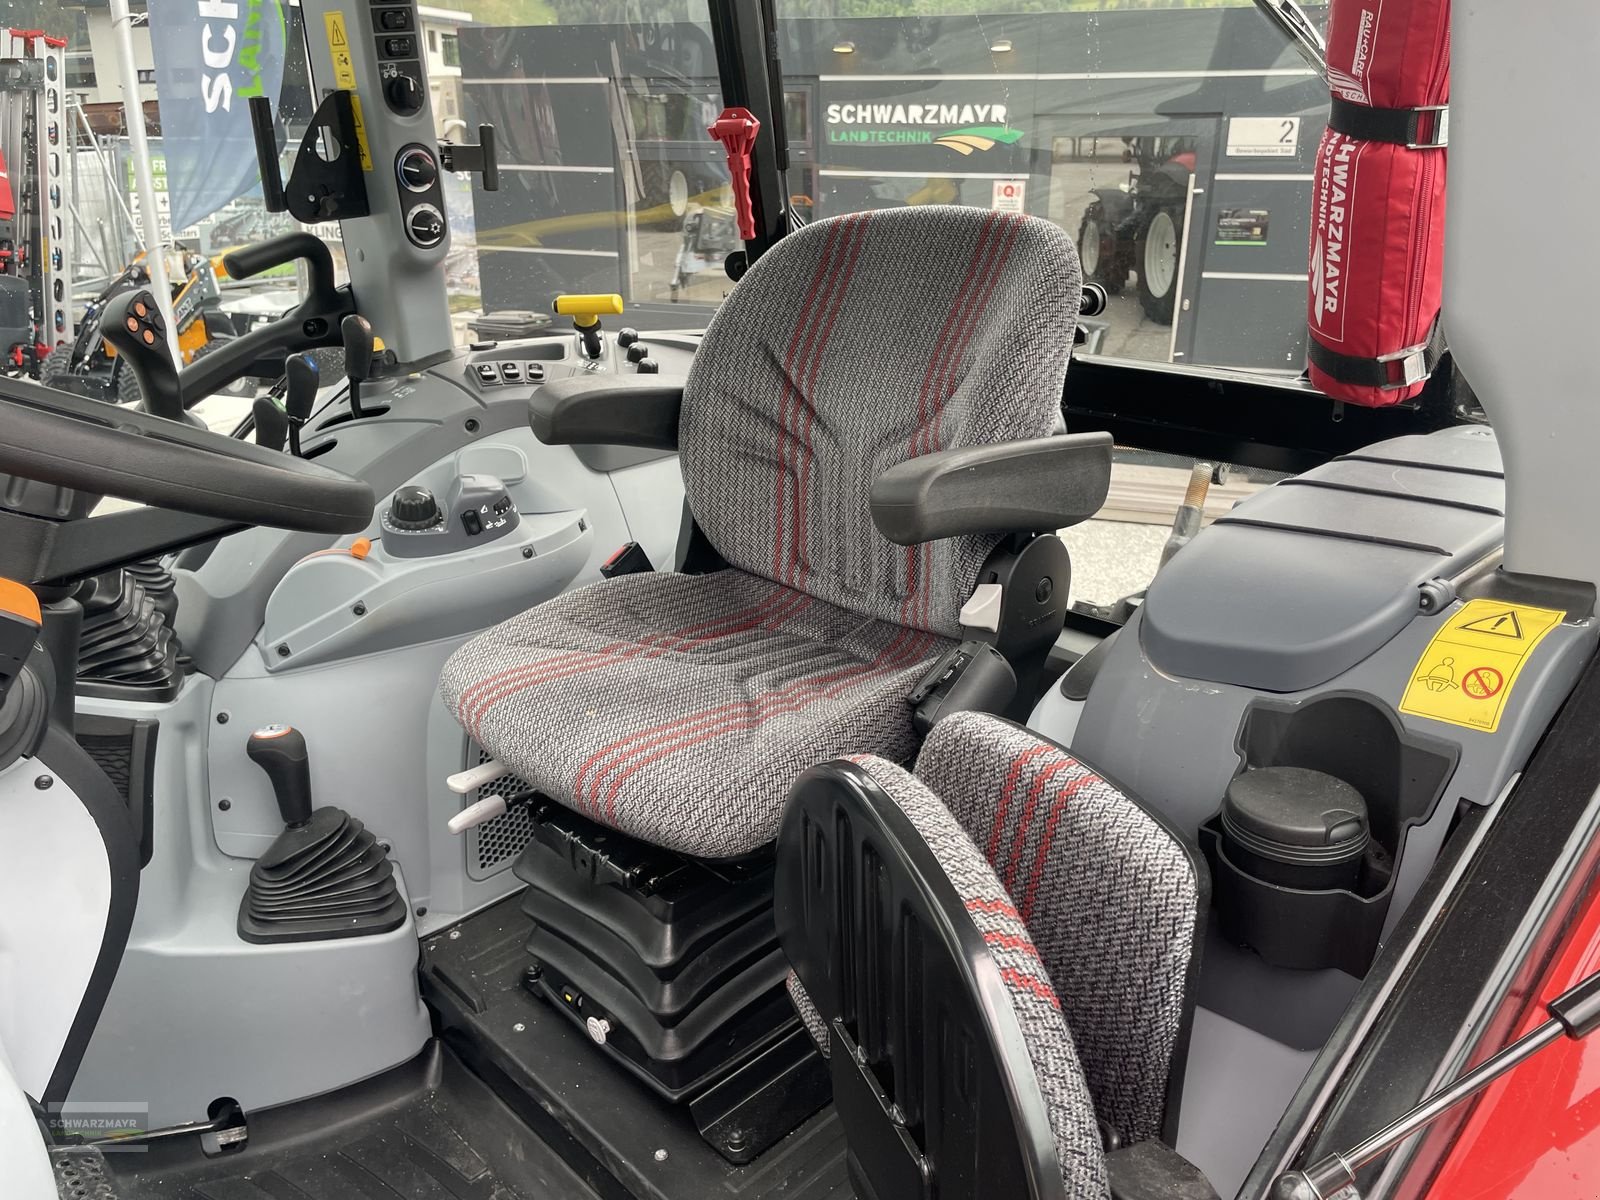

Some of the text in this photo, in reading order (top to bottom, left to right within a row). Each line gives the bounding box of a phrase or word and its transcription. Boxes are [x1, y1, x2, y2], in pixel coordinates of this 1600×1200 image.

[827, 104, 1007, 124] SCHWARZMAYR
[831, 130, 932, 143] LANDTECHNIK
[1279, 120, 1294, 143] 2
[1318, 132, 1341, 230] NDTECHNIK
[1325, 136, 1356, 312] HWARZMAYR
